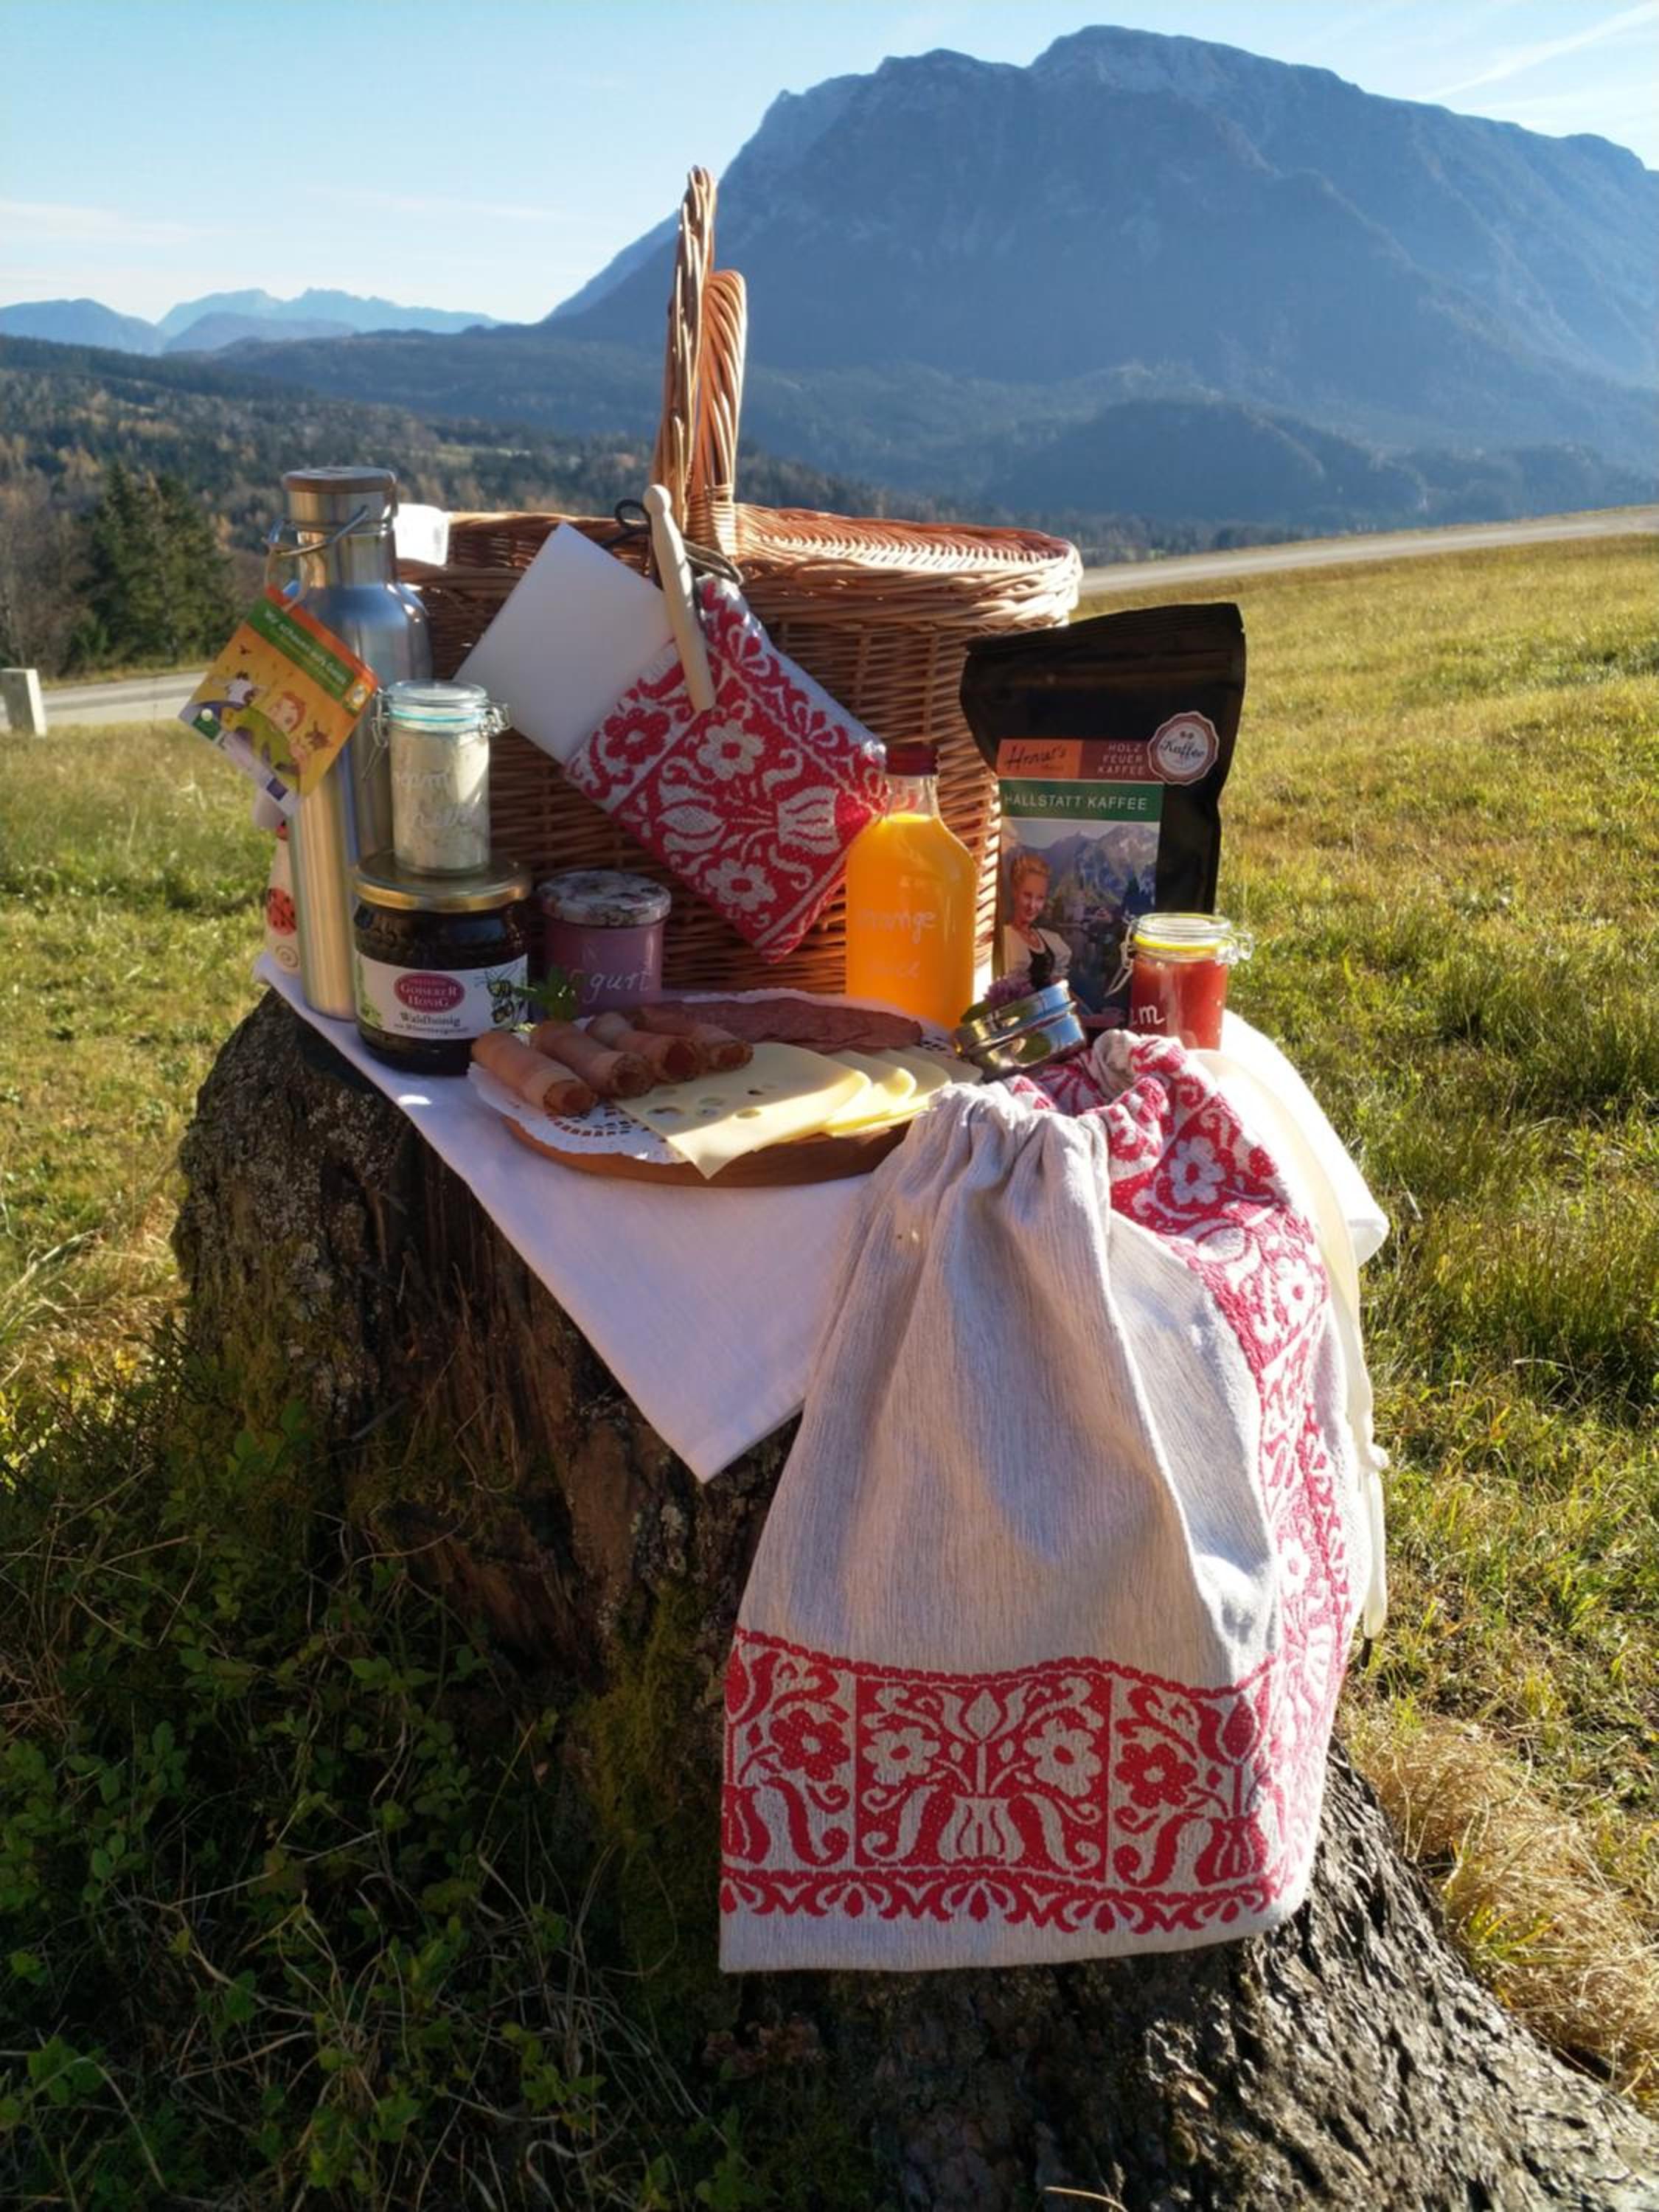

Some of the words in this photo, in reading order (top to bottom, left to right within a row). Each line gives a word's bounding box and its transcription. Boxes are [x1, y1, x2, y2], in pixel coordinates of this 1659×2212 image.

[1108, 742, 1142, 752] HOLZ
[1102, 754, 1143, 764] FEUER
[1097, 765, 1146, 776] KAFFEE
[1004, 795, 1082, 809] HALLSTATT
[1087, 796, 1148, 810] KAFFEE
